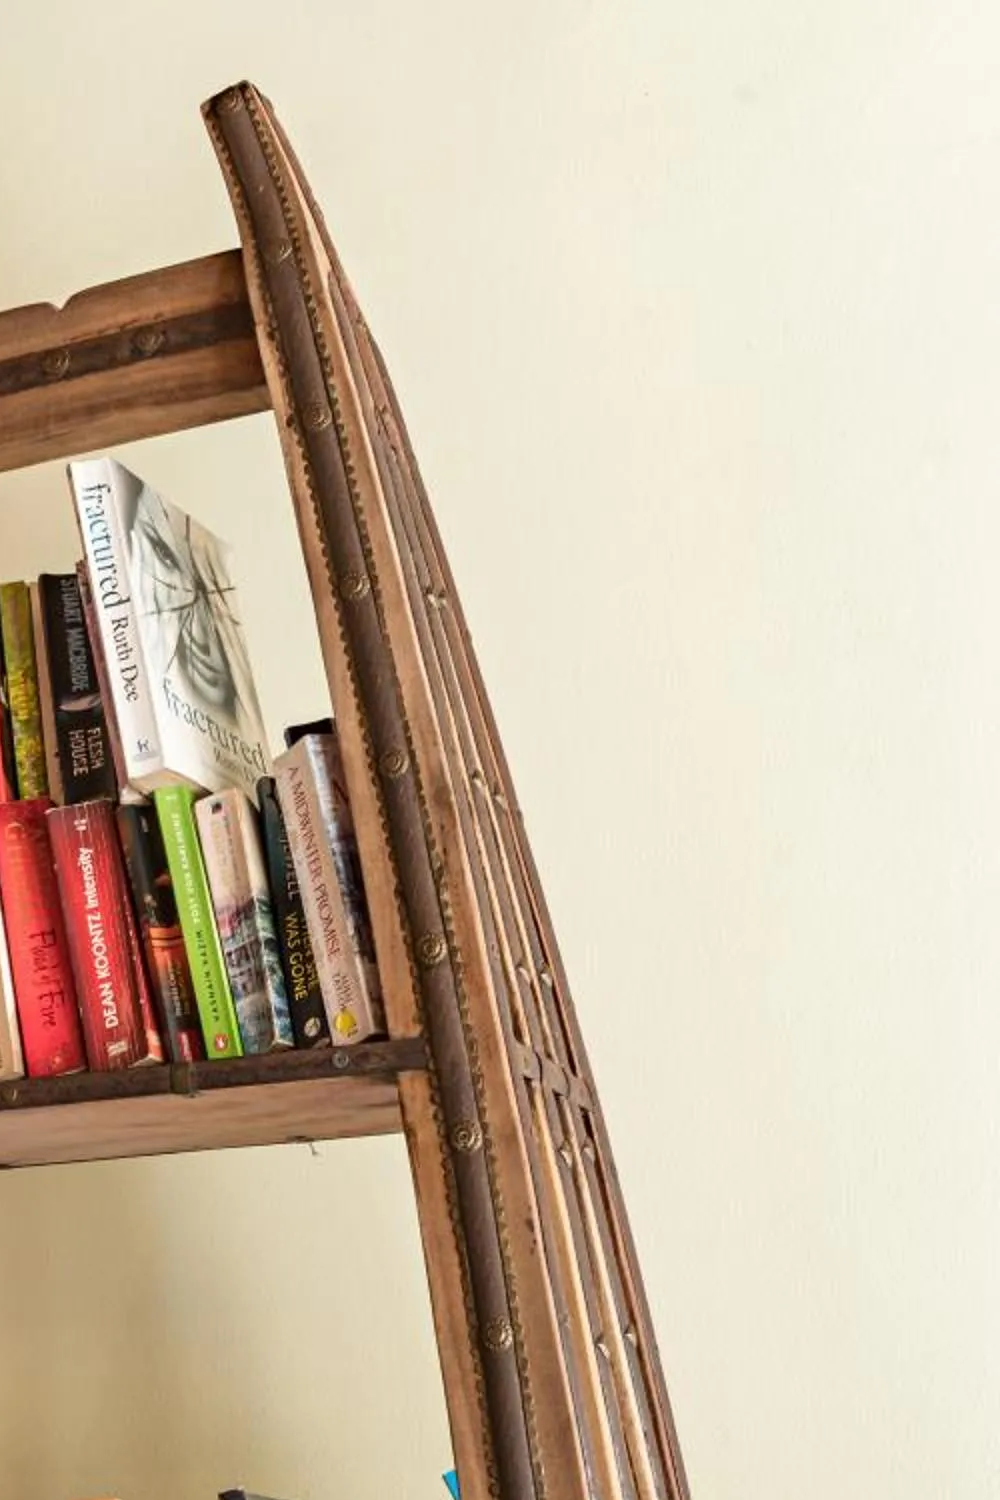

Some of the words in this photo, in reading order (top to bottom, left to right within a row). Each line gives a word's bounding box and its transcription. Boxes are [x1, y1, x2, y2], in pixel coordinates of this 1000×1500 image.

[82, 482, 131, 609] fractured
[60, 577, 82, 626] STUART
[66, 627, 90, 692] MACBRIDE
[111, 616, 133, 662] Ruth
[119, 665, 140, 704] Dee
[68, 730, 89, 777] HOUSE
[87, 727, 105, 769] FLESH
[77, 848, 99, 908] Intensity
[87, 912, 111, 979] KOONTZ
[286, 912, 304, 943] WAS
[314, 882, 342, 966] PROMISE
[289, 949, 308, 1001] GONE
[100, 987, 119, 1029] DEAN
